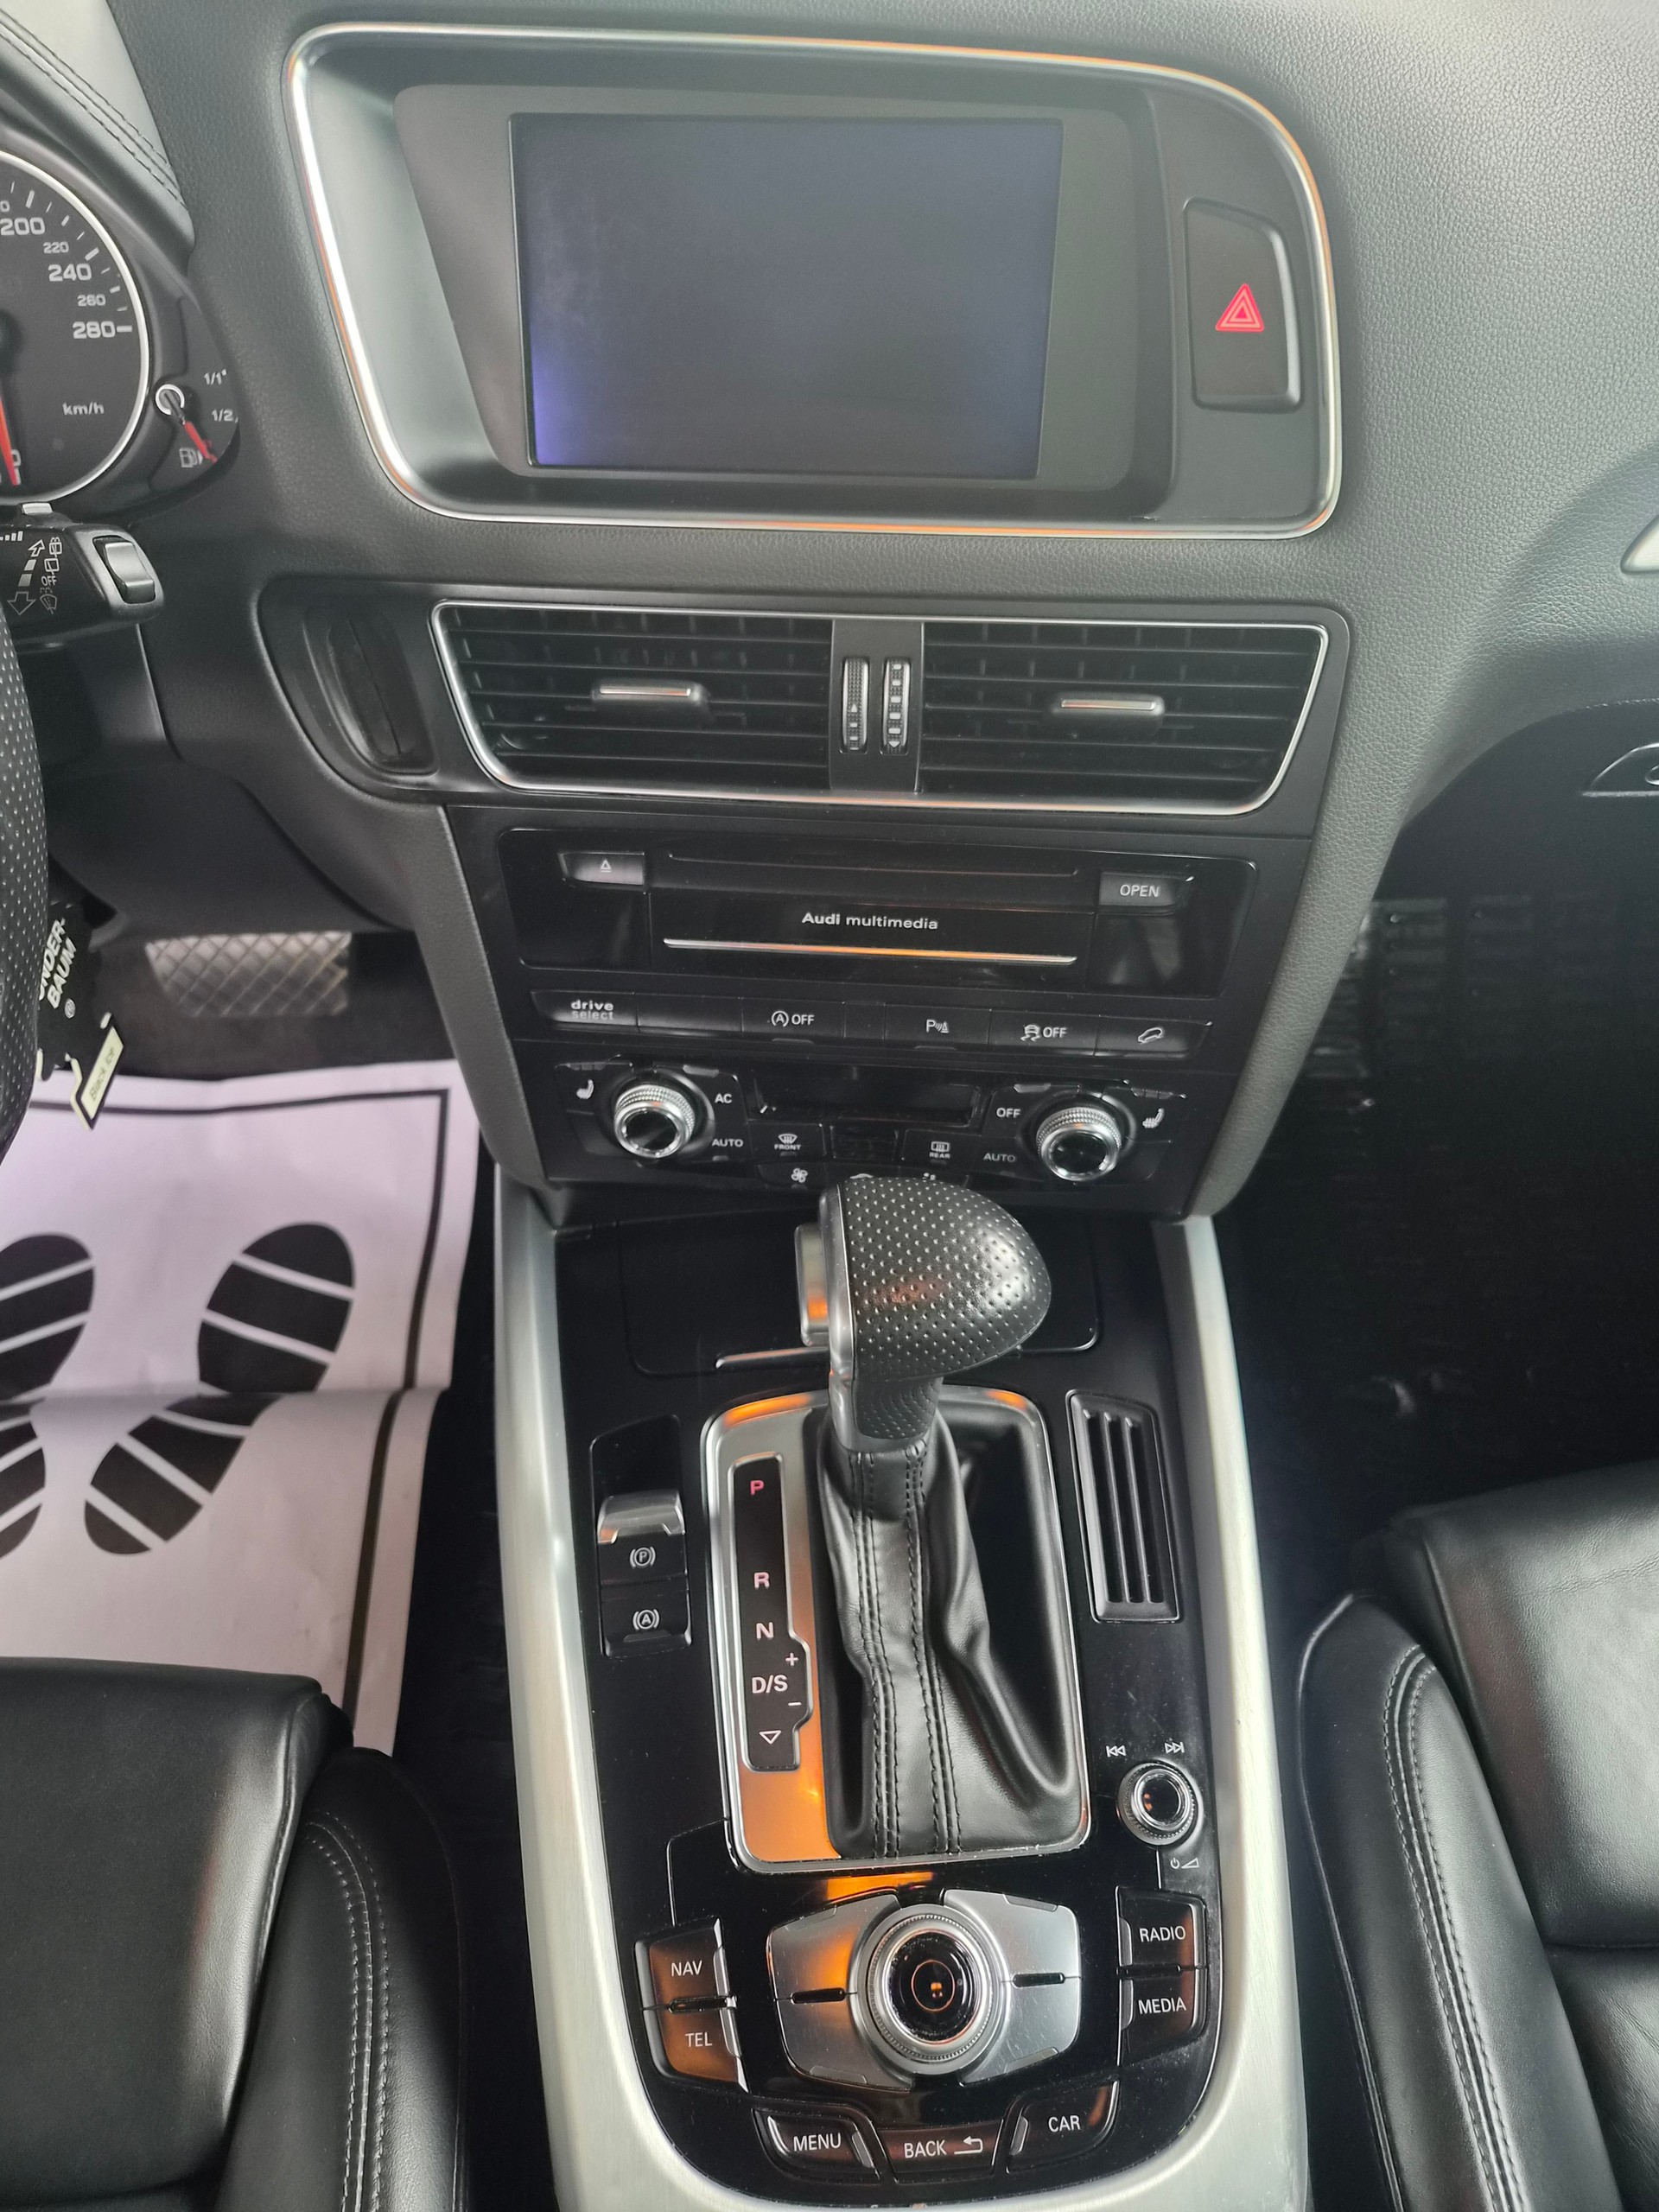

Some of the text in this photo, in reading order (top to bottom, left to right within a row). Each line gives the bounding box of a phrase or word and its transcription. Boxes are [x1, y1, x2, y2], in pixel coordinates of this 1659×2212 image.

[0, 217, 45, 236] 200
[43, 241, 69, 254] 220
[48, 263, 92, 282] 240
[77, 293, 106, 307] 260
[73, 321, 116, 339] 280
[62, 402, 105, 416] km/h
[212, 408, 234, 422] 1/2
[41, 575, 57, 587] OFF
[1119, 883, 1160, 899] OPEN
[801, 912, 939, 931] Audi multimedia
[47, 937, 77, 1009] BAUM
[570, 999, 614, 1012] drive
[571, 1010, 613, 1020] select
[791, 1014, 815, 1027] OFF
[1042, 1027, 1067, 1039] OFF
[715, 1092, 733, 1105] AC
[995, 1107, 1021, 1119] OFF
[711, 1137, 744, 1148] AUTO
[773, 1143, 802, 1152] FRONT
[929, 1151, 950, 1160] REAR
[982, 1152, 1016, 1163] AUTO
[749, 1480, 764, 1496] P
[753, 1572, 770, 1589] R
[755, 1622, 774, 1639] N
[751, 1674, 789, 1694] D/S
[1139, 1925, 1186, 1943] RADIO
[671, 1958, 703, 1978] NAV
[1138, 1995, 1188, 2015] MEDIA
[684, 2031, 714, 2049] TEL
[1047, 2113, 1082, 2134] CAR
[791, 2131, 842, 2152] MENU
[903, 2139, 947, 2159] BACK
